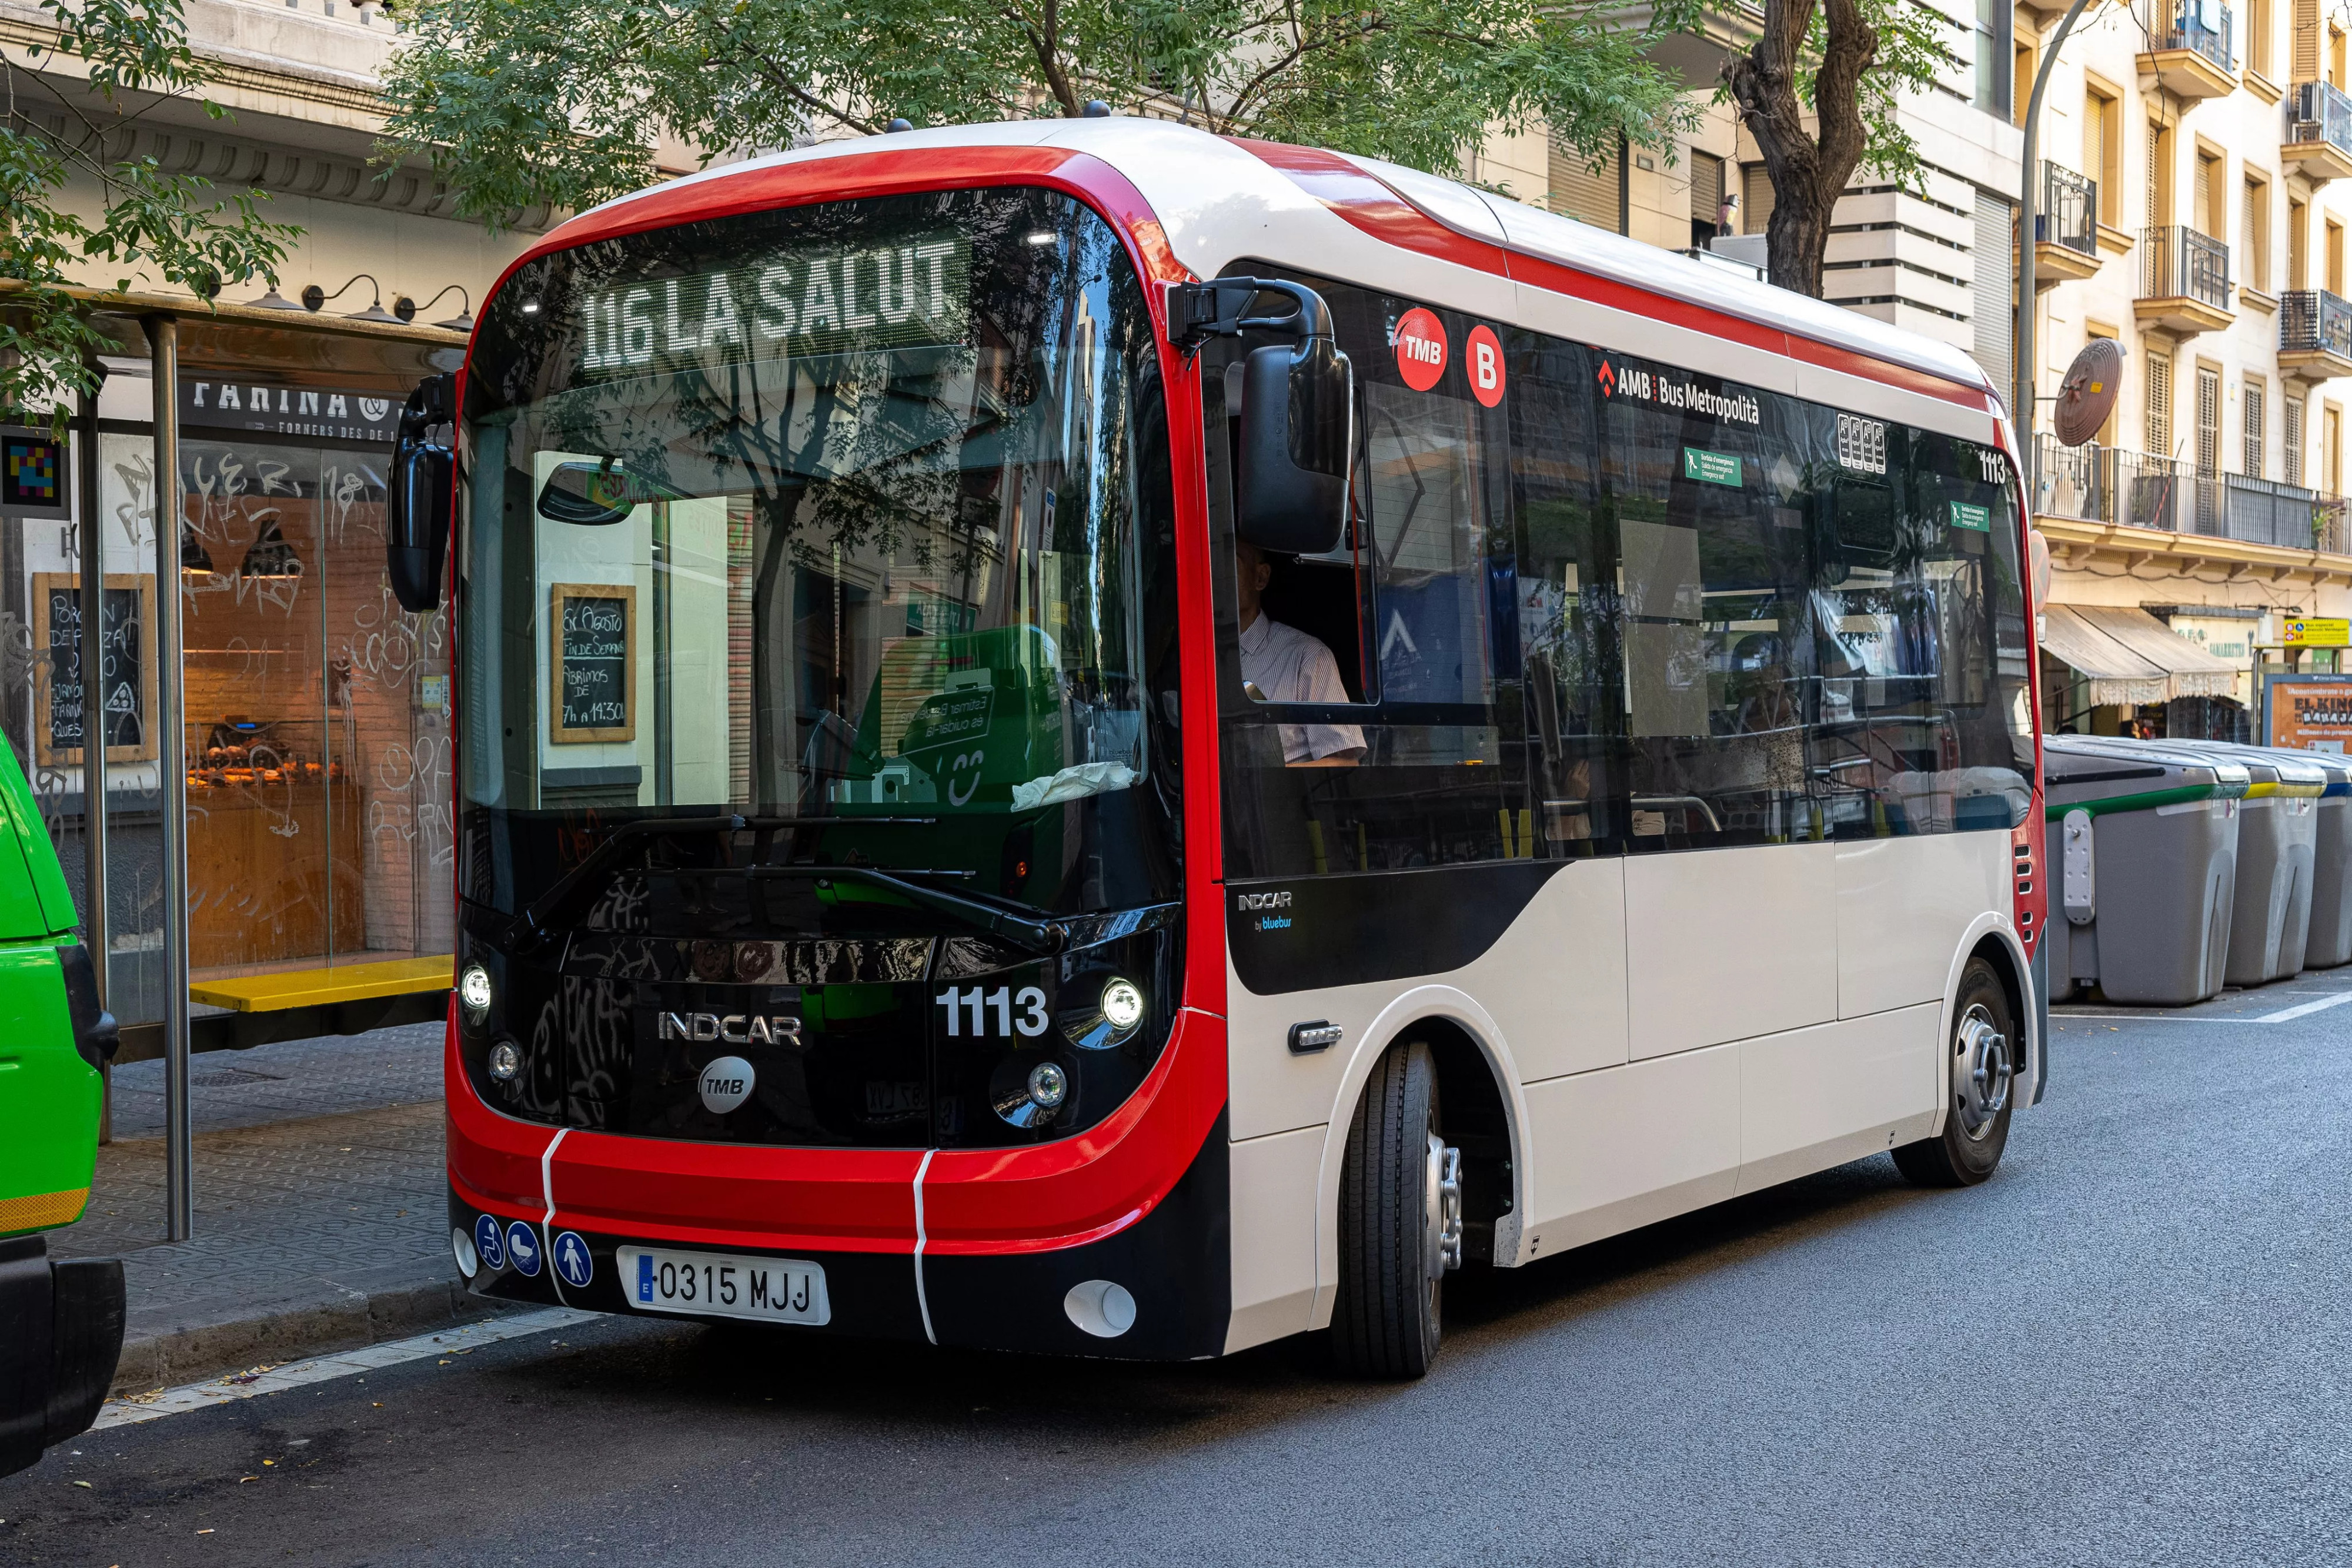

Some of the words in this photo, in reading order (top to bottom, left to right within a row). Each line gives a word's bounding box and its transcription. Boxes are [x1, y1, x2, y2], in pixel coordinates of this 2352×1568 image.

[584, 288, 653, 369] 116
[666, 273, 740, 350] LA
[759, 242, 955, 339] SALUT
[1405, 335, 1442, 365] TMB
[1476, 343, 1497, 390] B
[1619, 367, 1651, 400] AMB
[1659, 376, 1684, 407] Bus
[1685, 383, 1759, 424] Metropolità
[279, 422, 333, 437] FORNERS
[341, 426, 362, 439] DES
[369, 430, 383, 441] DE
[1979, 450, 2006, 484] 1113
[582, 606, 623, 632] AGOSTO
[593, 635, 624, 656] SEMANA
[574, 684, 590, 698] DE
[2294, 698, 2314, 710] EL
[1238, 891, 1292, 911] INDCAR
[1255, 921, 1262, 932] by
[1262, 915, 1291, 930] bluebus
[936, 986, 1049, 1037] 1113
[658, 1011, 801, 1045] INDCAR
[706, 1078, 744, 1096] TMB
[642, 1282, 650, 1293] E
[660, 1261, 737, 1306] 0315
[750, 1269, 810, 1313] MJJ
